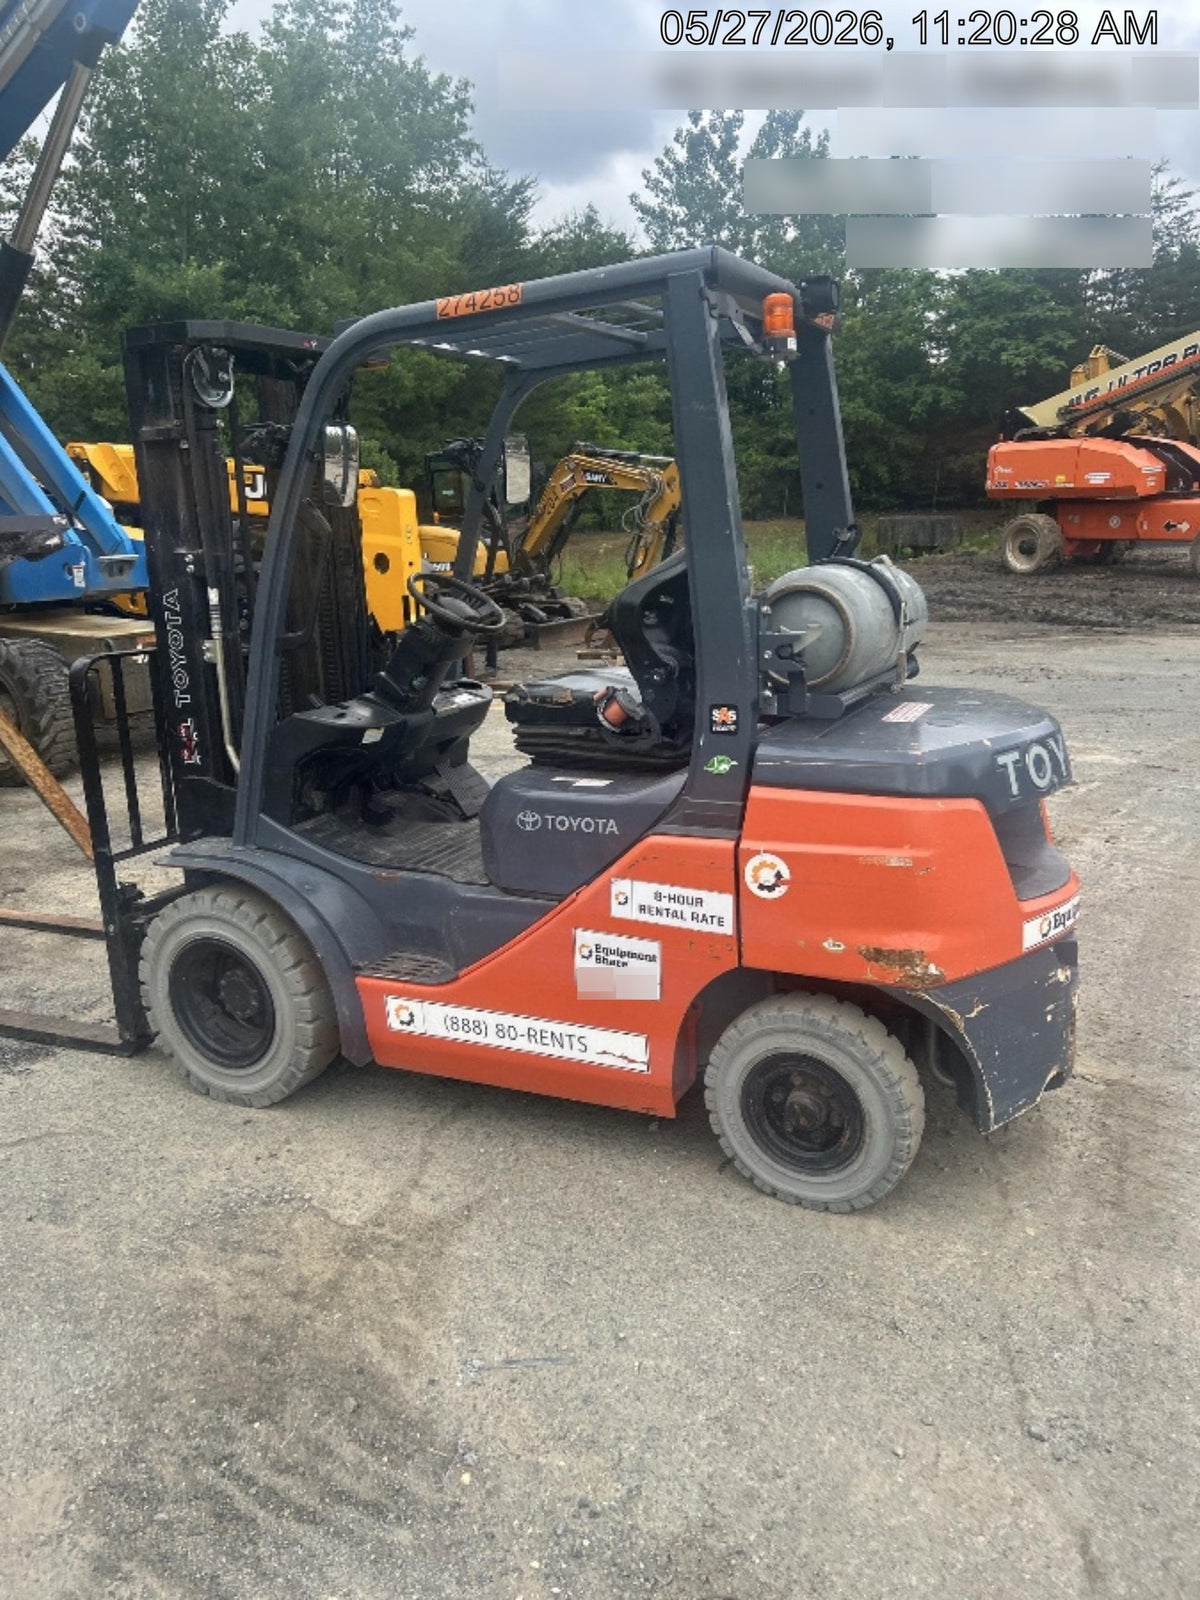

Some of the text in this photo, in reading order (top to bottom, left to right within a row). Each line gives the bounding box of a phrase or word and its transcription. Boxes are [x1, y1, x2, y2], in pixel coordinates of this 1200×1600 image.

[438, 284, 520, 317] 274258
[162, 588, 191, 708] TOYOTA
[545, 815, 619, 834] TOYOTA
[653, 890, 704, 908] 8-HOUR
[638, 904, 725, 927] RENTAL RATE
[594, 943, 657, 962] Equipment
[443, 1015, 588, 1053] (888) 80-RENTS
